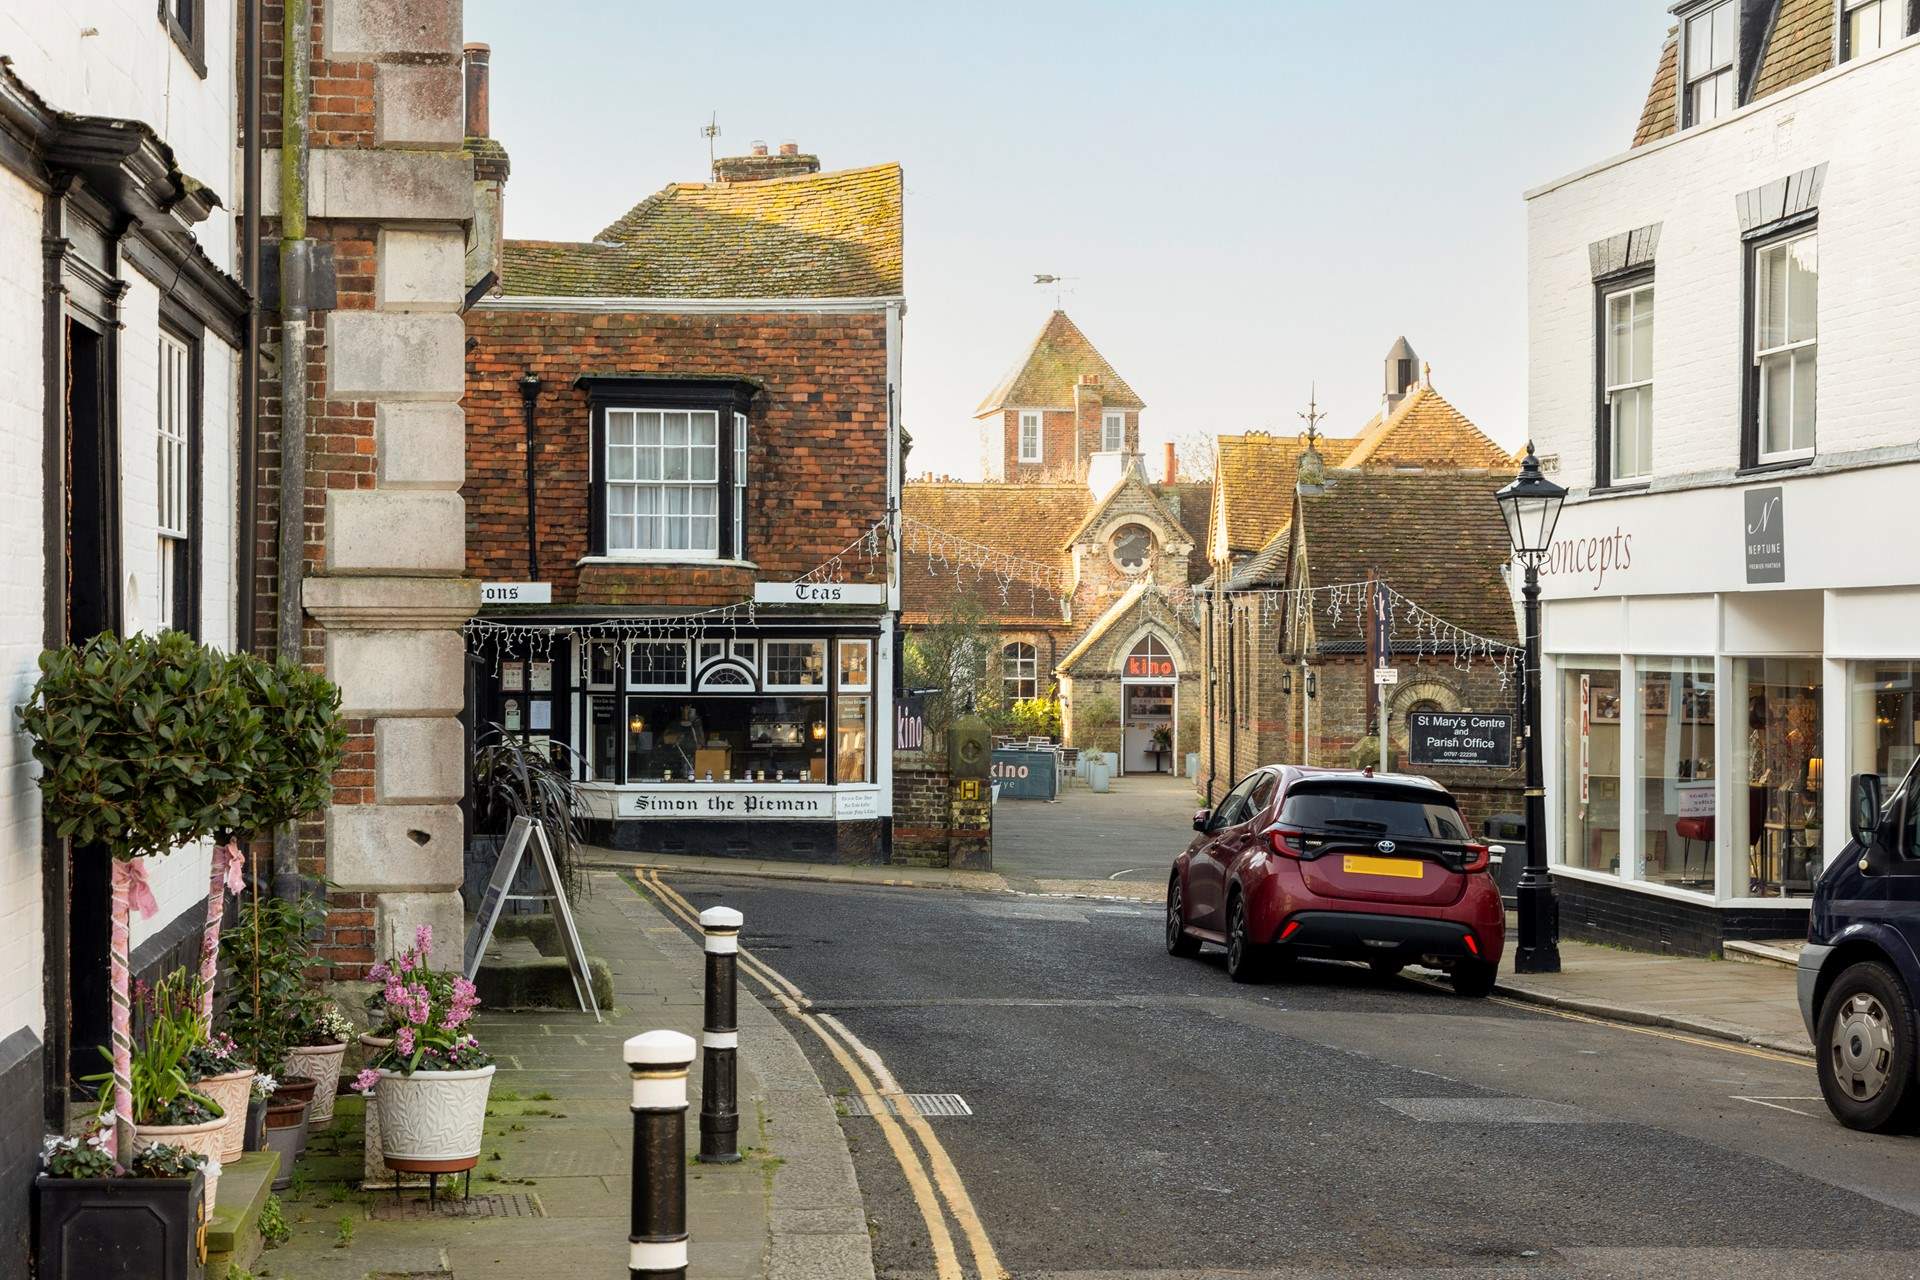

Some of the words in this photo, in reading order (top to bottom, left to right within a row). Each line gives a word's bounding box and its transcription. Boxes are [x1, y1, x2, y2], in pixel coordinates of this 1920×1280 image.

[1748, 543, 1781, 555] NEPTUNE
[1538, 526, 1632, 591] oncepts
[481, 586, 519, 600] ons
[795, 584, 842, 600] Teas
[1130, 657, 1172, 675] kino
[897, 705, 922, 749] kino
[1417, 715, 1430, 726] St
[1433, 716, 1467, 729] Mary's
[1471, 717, 1506, 728] Centre
[1453, 728, 1470, 736] and
[1427, 736, 1460, 748] Parish
[1463, 738, 1496, 749] Office
[634, 795, 699, 811] Simon
[708, 796, 736, 813] the
[744, 795, 820, 813] Pieman
